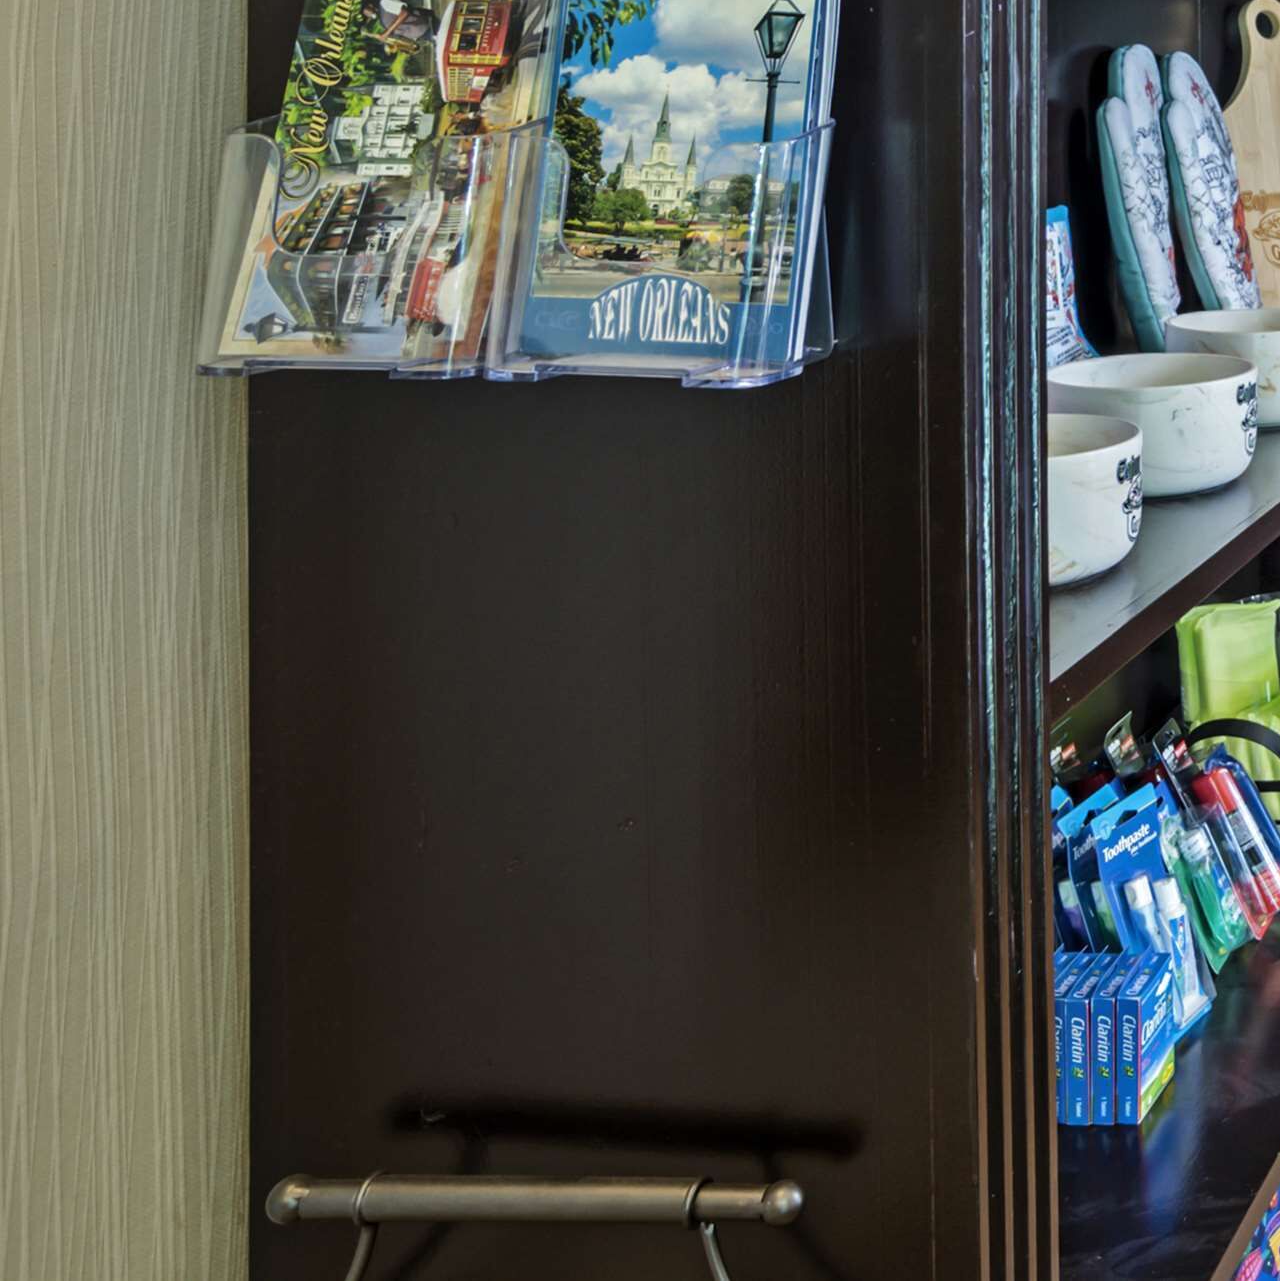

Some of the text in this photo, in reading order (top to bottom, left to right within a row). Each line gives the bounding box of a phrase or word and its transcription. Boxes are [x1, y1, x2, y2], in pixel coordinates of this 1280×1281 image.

[588, 277, 731, 345] NEW ORLEANS
[1102, 823, 1151, 863] Toothpaste
[1071, 1017, 1086, 1064] Claritin
[1096, 1015, 1112, 1063] Claritin
[1122, 1014, 1137, 1062] Claritin
